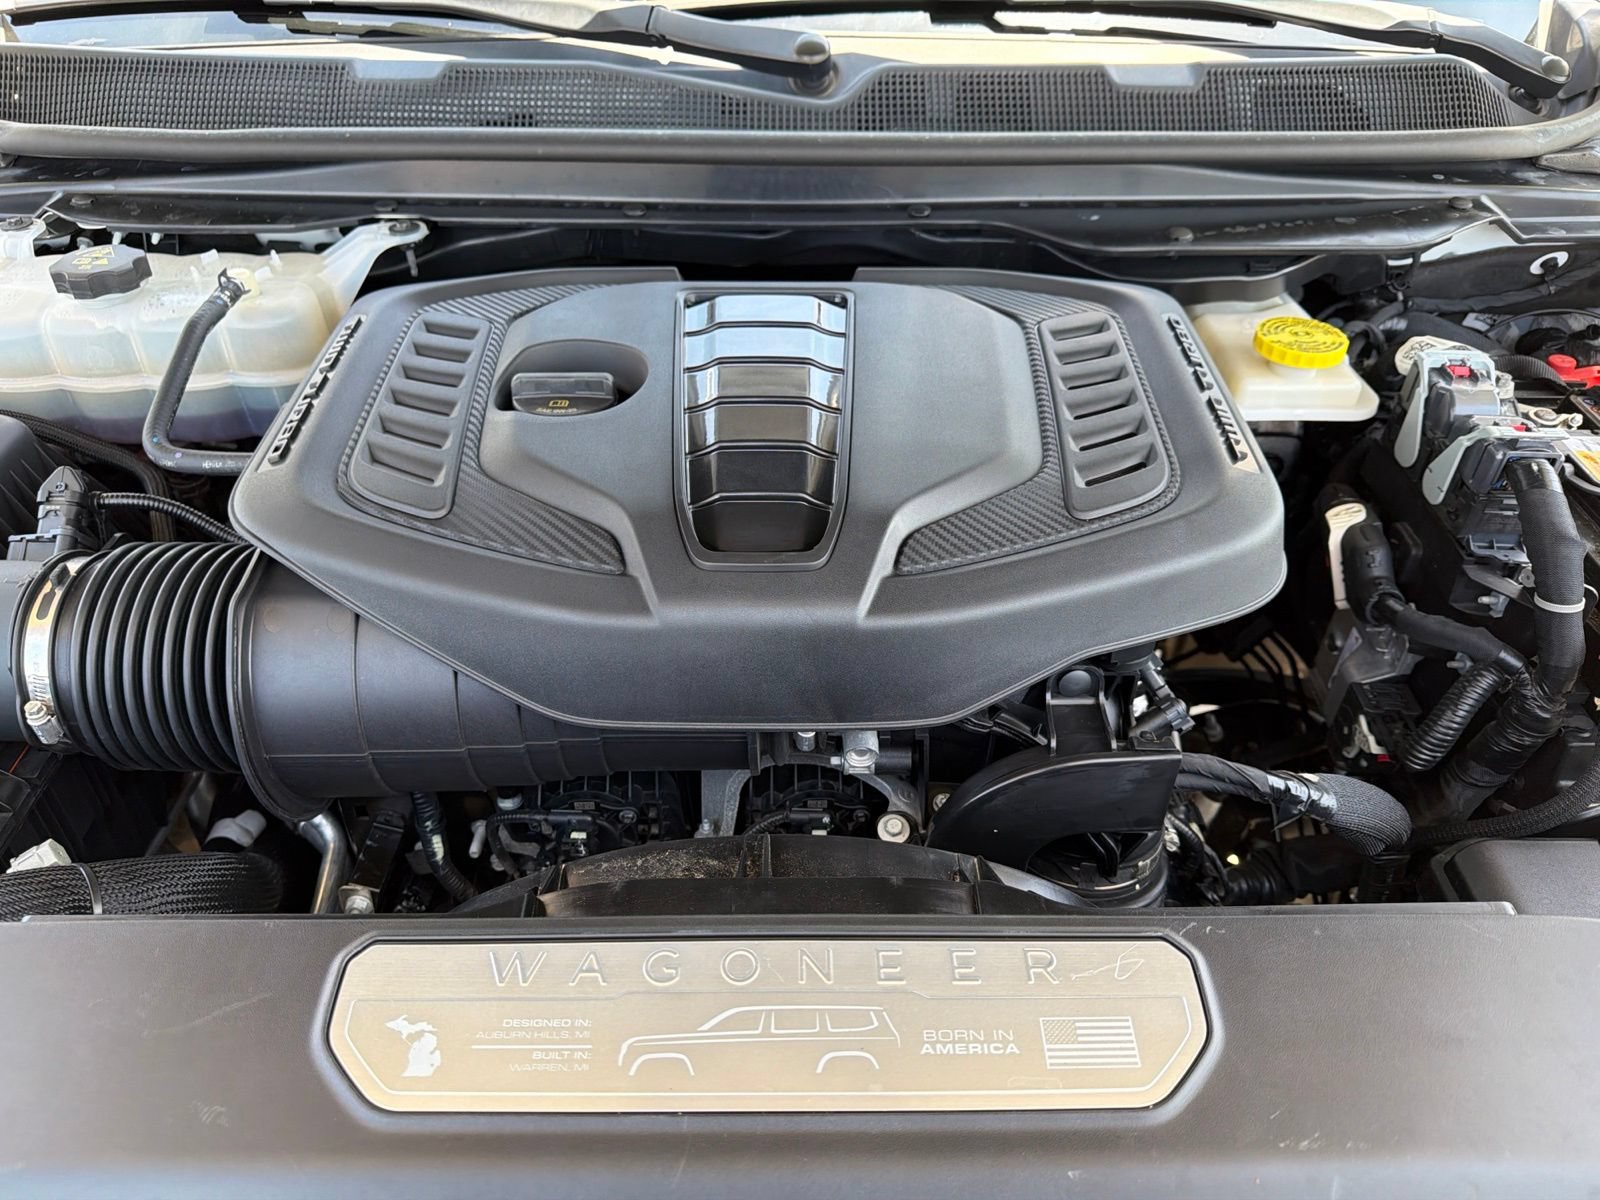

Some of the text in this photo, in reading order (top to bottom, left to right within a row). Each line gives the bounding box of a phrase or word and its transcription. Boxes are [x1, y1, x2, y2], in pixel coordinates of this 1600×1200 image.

[1166, 316, 1214, 394] TURBO
[267, 373, 330, 465] TURBO
[489, 948, 1061, 988] WAGONEER
[502, 1018, 593, 1028] DESIGNED IN:
[475, 1030, 532, 1040] AUBURN
[574, 1031, 592, 1039] MI
[922, 1029, 1015, 1042] BORN IN
[532, 1050, 593, 1060] BUILT IN:
[919, 1042, 1021, 1055] AMERICA
[573, 1063, 591, 1072] MI
